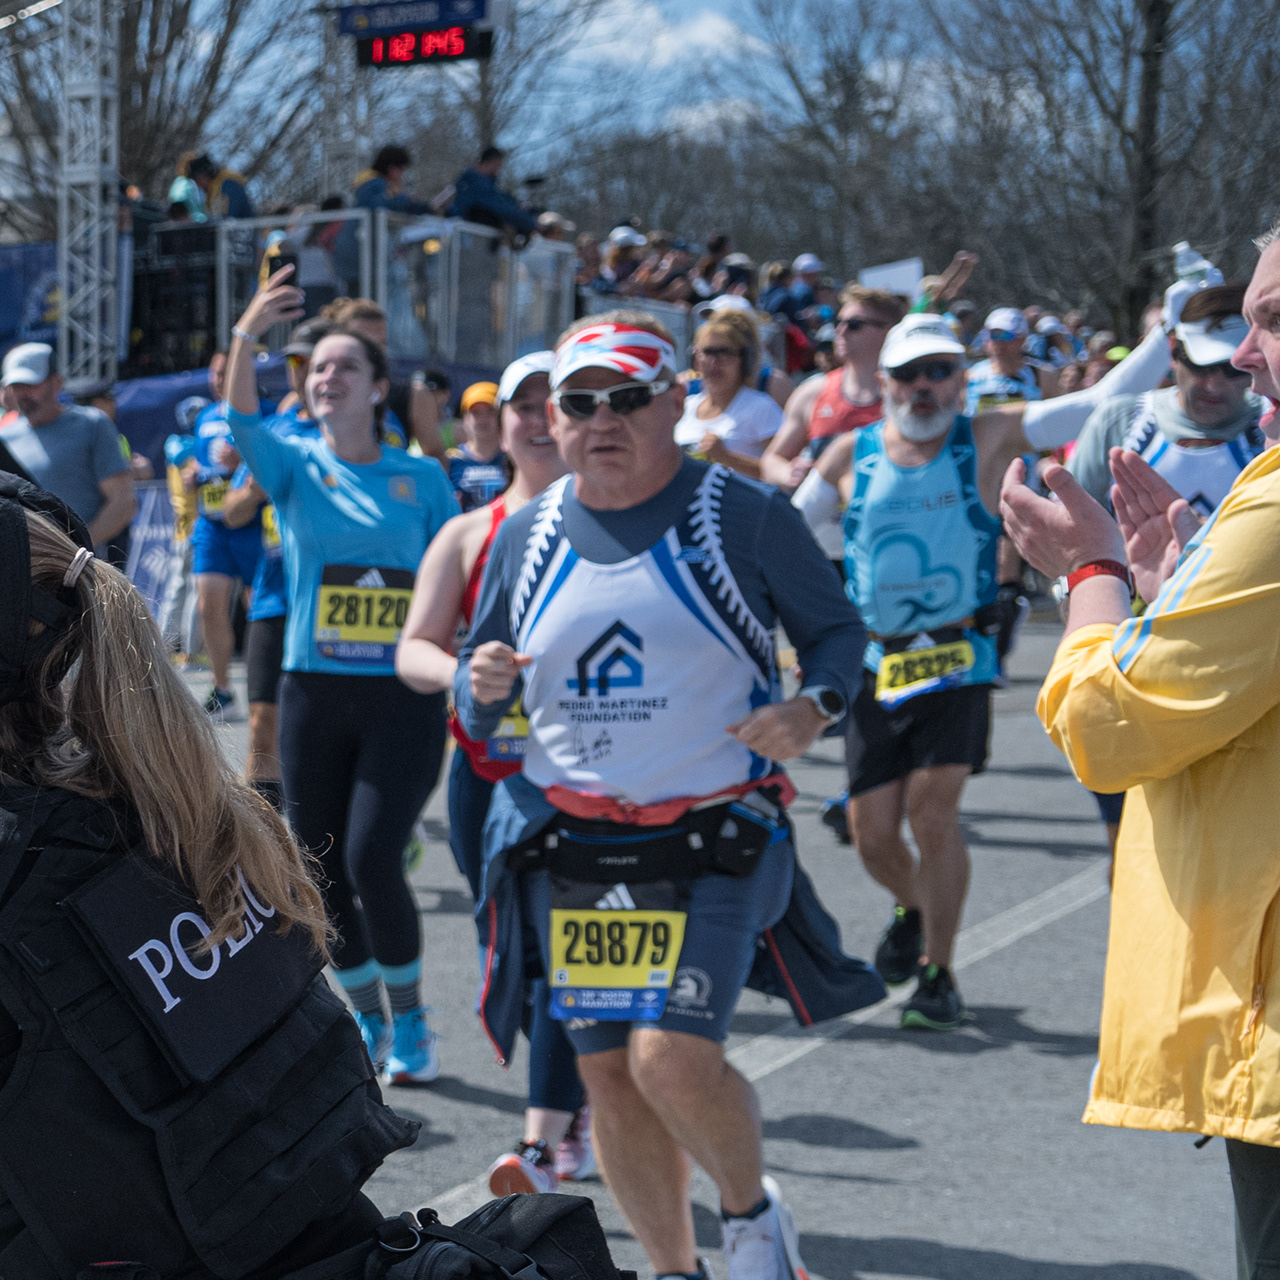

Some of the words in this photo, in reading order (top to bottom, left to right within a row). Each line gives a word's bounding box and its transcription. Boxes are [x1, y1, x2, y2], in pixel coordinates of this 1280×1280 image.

[327, 594, 408, 628] 28120
[559, 701, 594, 711] PEDRO
[599, 697, 668, 710] MARTINEZ
[570, 711, 652, 723] FOUNDATION
[563, 921, 671, 966] 29879
